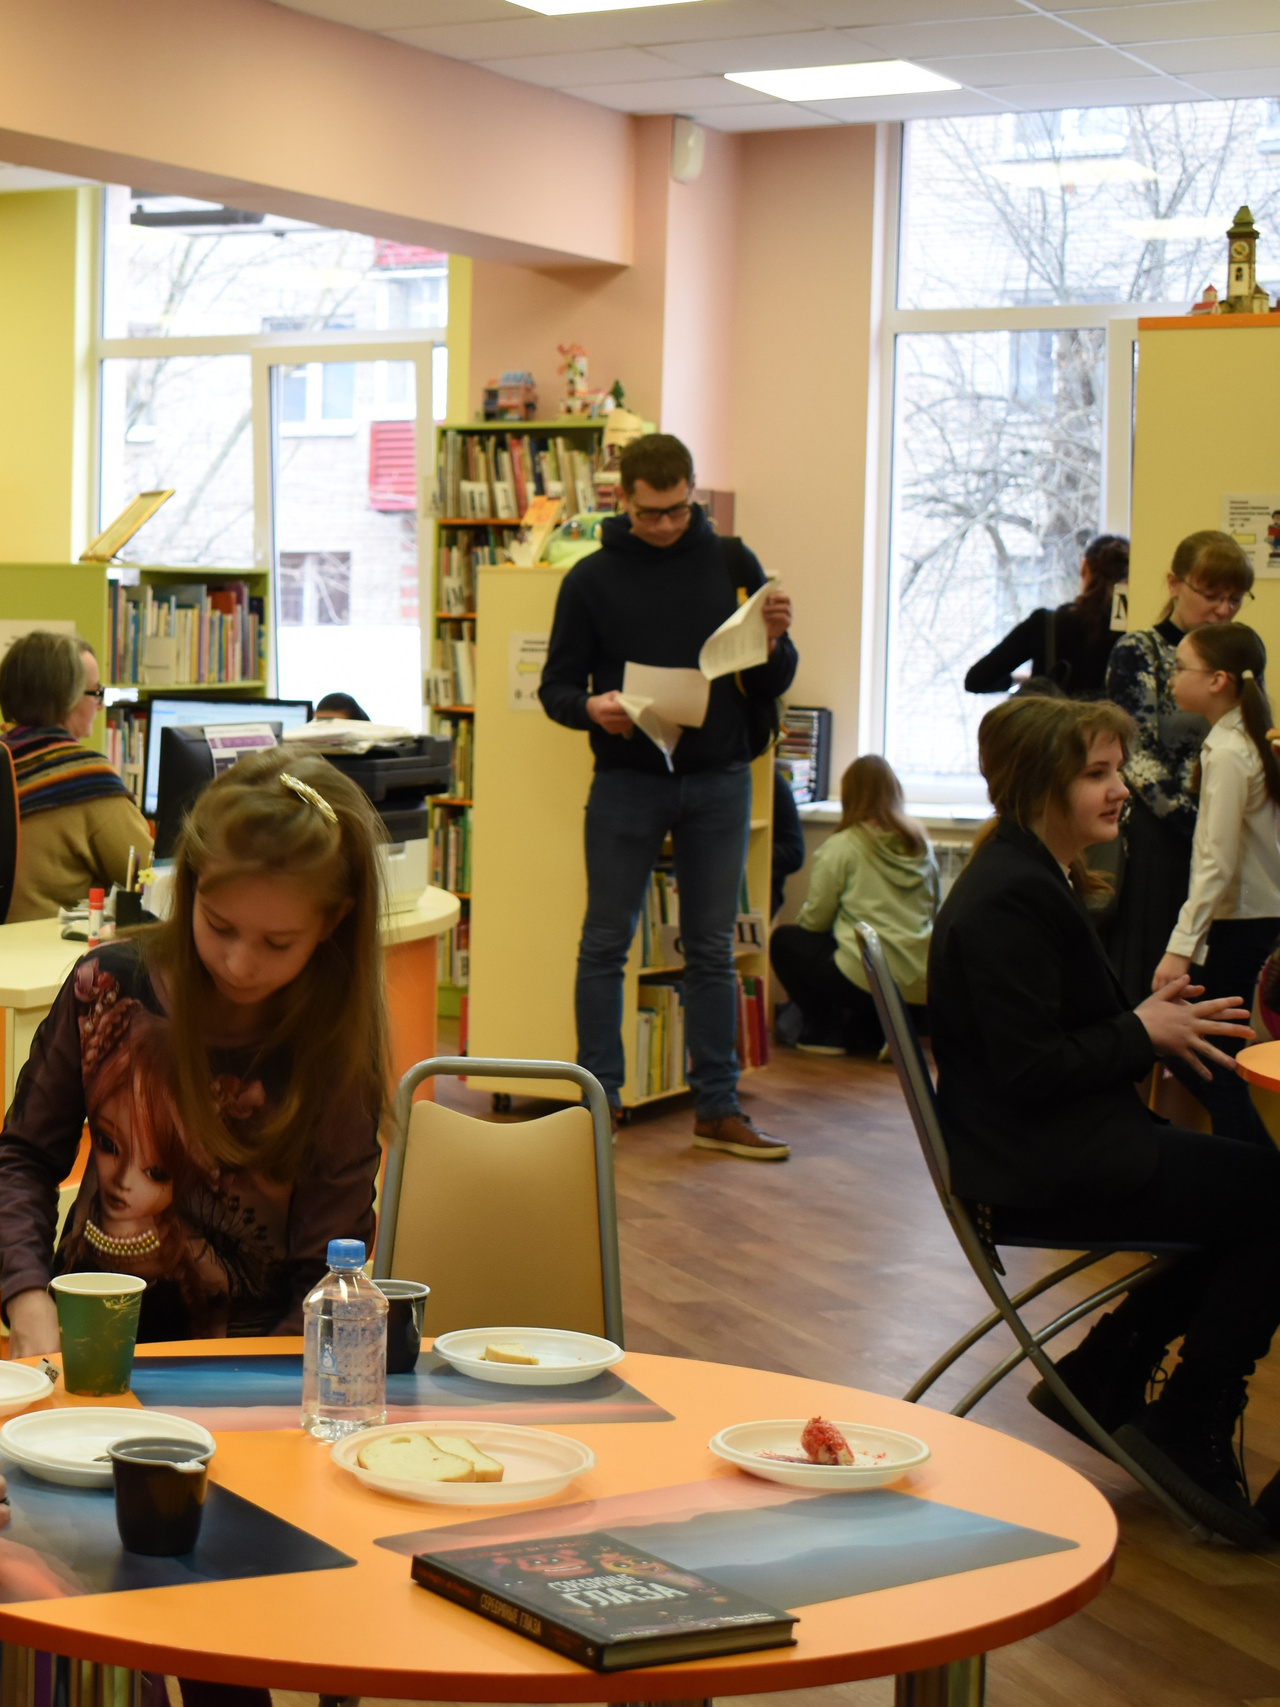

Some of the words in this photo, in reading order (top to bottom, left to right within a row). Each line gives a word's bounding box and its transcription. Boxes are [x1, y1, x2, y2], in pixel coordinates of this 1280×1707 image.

[547, 1573, 644, 1593] СЕРЕБРЯНЫЕ
[559, 1582, 689, 1608] ГЛАЗА
[480, 1593, 520, 1625] СЕРЕБРЯНЫЕ
[519, 1612, 542, 1636] ГЛАЗА
